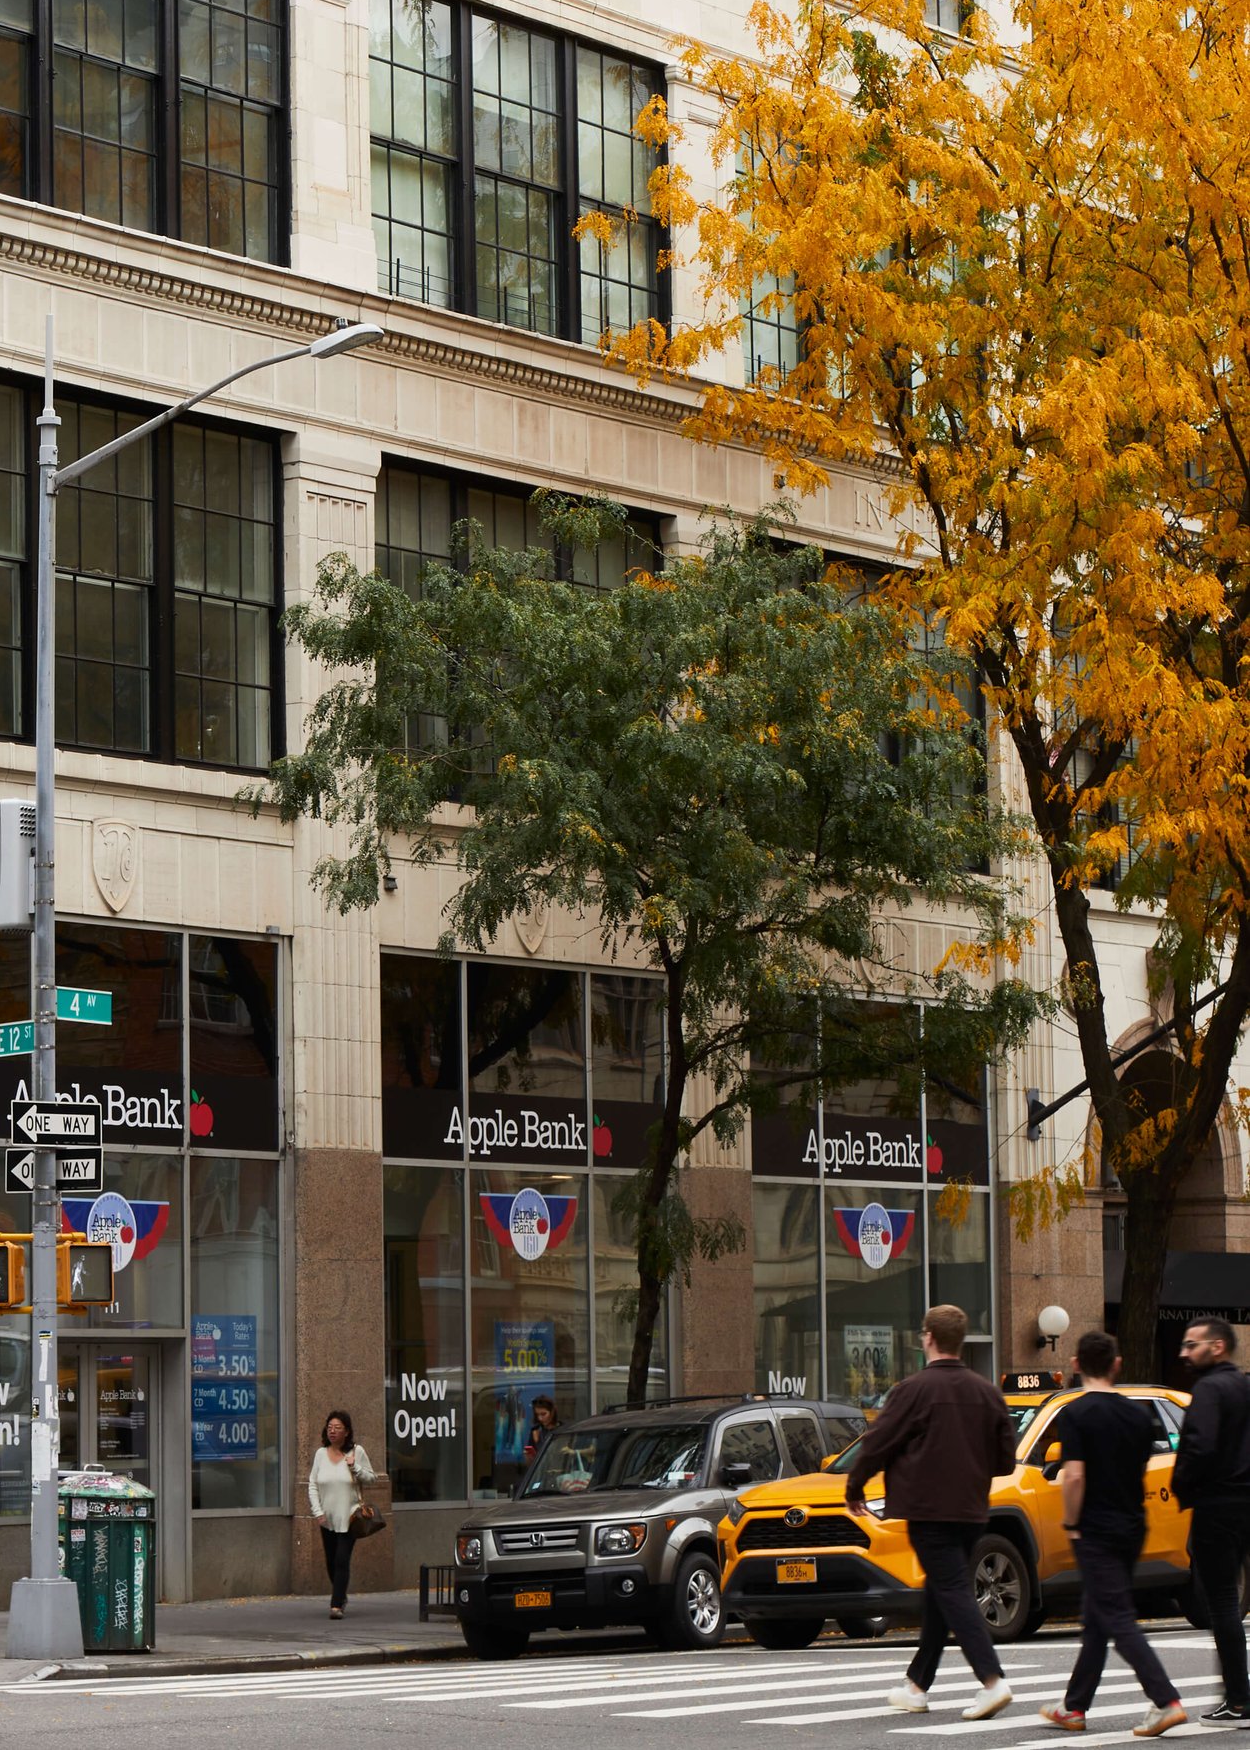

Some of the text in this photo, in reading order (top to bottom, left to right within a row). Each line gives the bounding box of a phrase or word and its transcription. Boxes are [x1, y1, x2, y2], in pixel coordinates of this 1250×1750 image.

[70, 993, 96, 1016] 4 AV
[9, 1027, 20, 1051] 12
[24, 1026, 32, 1039] ST
[102, 1084, 183, 1129] Bank
[26, 1115, 89, 1133] ONE WAY
[444, 1106, 587, 1155] Apple Bank
[802, 1128, 922, 1173] Apple Bank
[62, 1161, 90, 1178] WAY
[91, 1214, 121, 1230] Apple
[513, 1208, 538, 1223] Apple
[513, 1221, 535, 1234] Bank
[861, 1221, 882, 1235] Apple
[91, 1229, 118, 1243] Bank
[861, 1233, 880, 1245] Bank
[195, 1322, 213, 1332] Apple
[232, 1322, 253, 1332] Today's
[195, 1331, 212, 1340] Bank
[234, 1331, 250, 1340] Rates
[199, 1354, 216, 1363] Month
[218, 1355, 255, 1376] 3.50%
[504, 1349, 547, 1373] 5.00%
[194, 1365, 204, 1373] CD
[401, 1373, 447, 1401] Now
[768, 1371, 806, 1396] Now
[1017, 1374, 1040, 1389] 8B36
[100, 1390, 137, 1402] Apple Bank
[199, 1388, 216, 1397] Month
[218, 1389, 255, 1410] 4.50%
[194, 1398, 204, 1407] CD
[218, 1422, 255, 1443] 4.00%
[394, 1408, 456, 1446] Open!
[195, 1432, 204, 1441] CD
